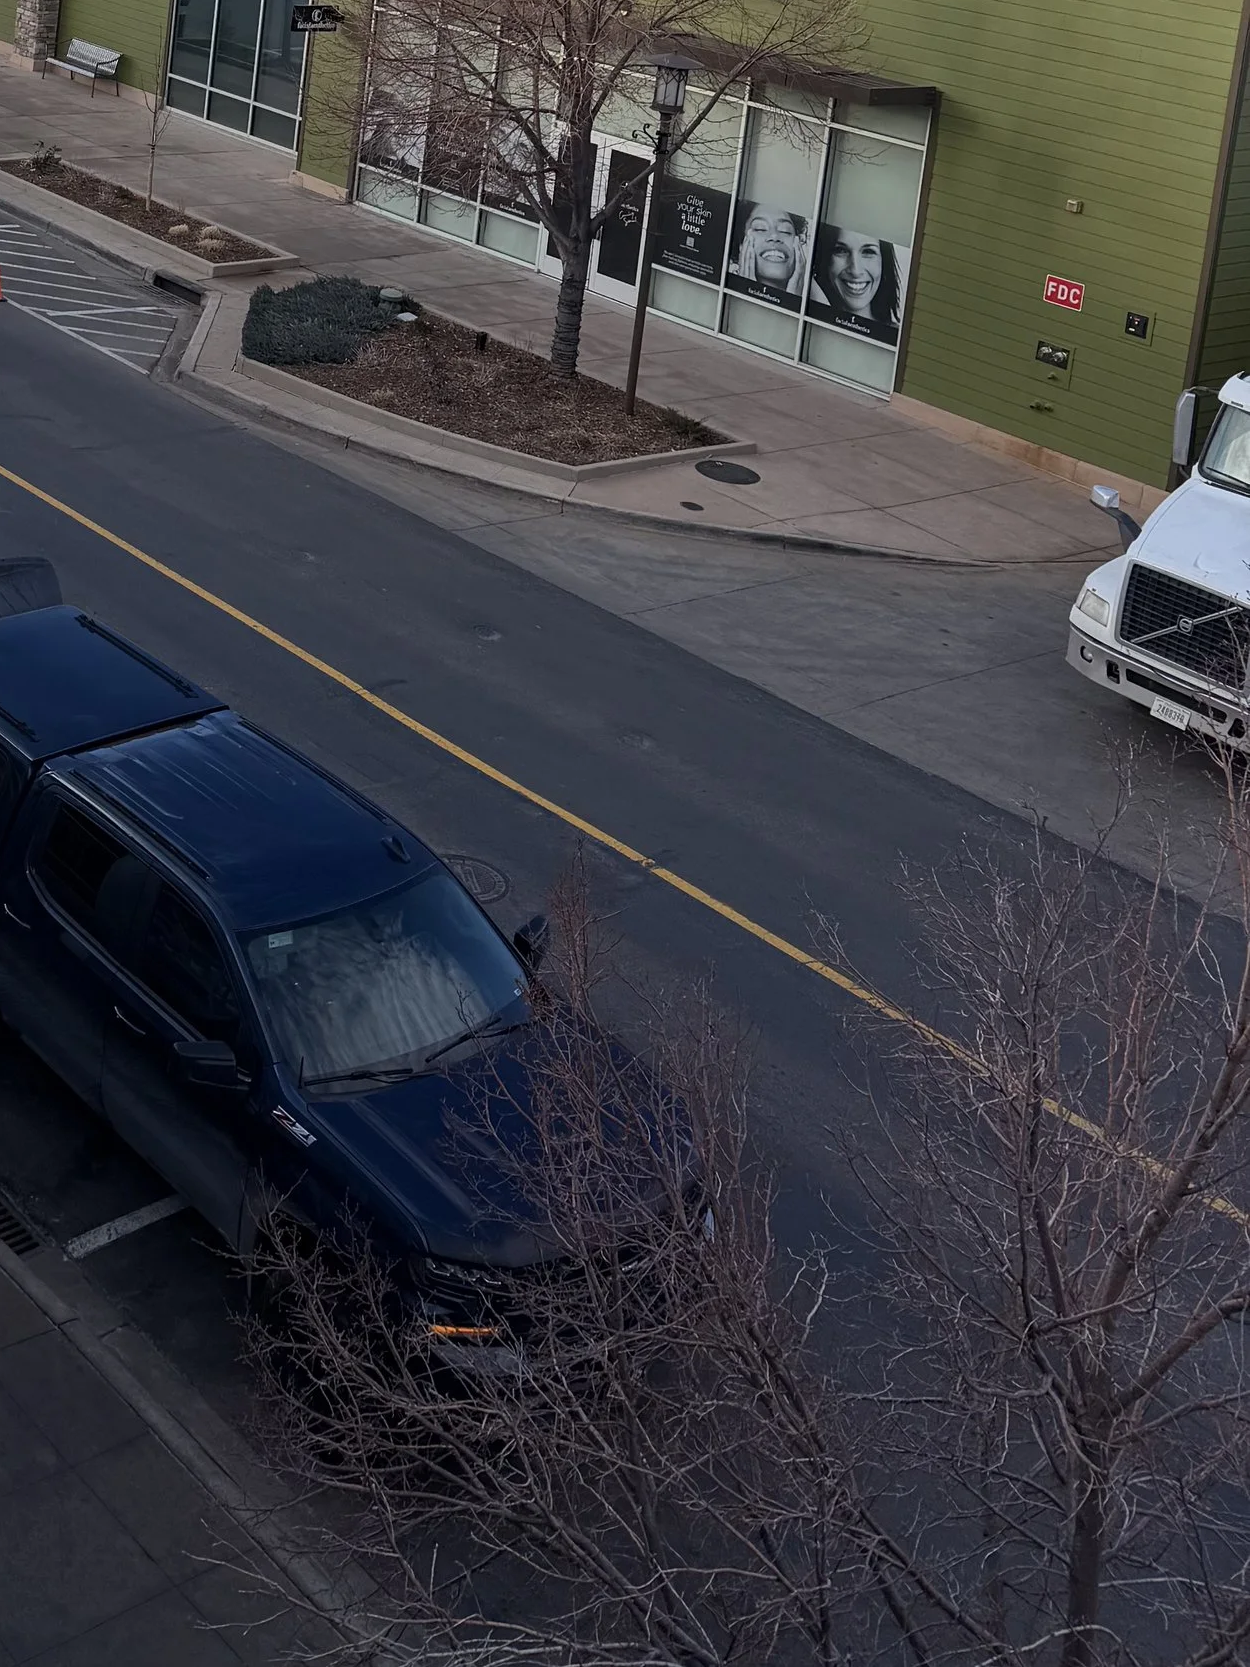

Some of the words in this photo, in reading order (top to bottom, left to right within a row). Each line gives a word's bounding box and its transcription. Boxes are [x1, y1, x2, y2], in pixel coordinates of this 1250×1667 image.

[687, 194, 704, 207] Give
[677, 202, 695, 213] your
[696, 207, 712, 218] skin
[687, 213, 705, 226] little
[681, 220, 702, 235] love.
[1047, 281, 1081, 304] FDC
